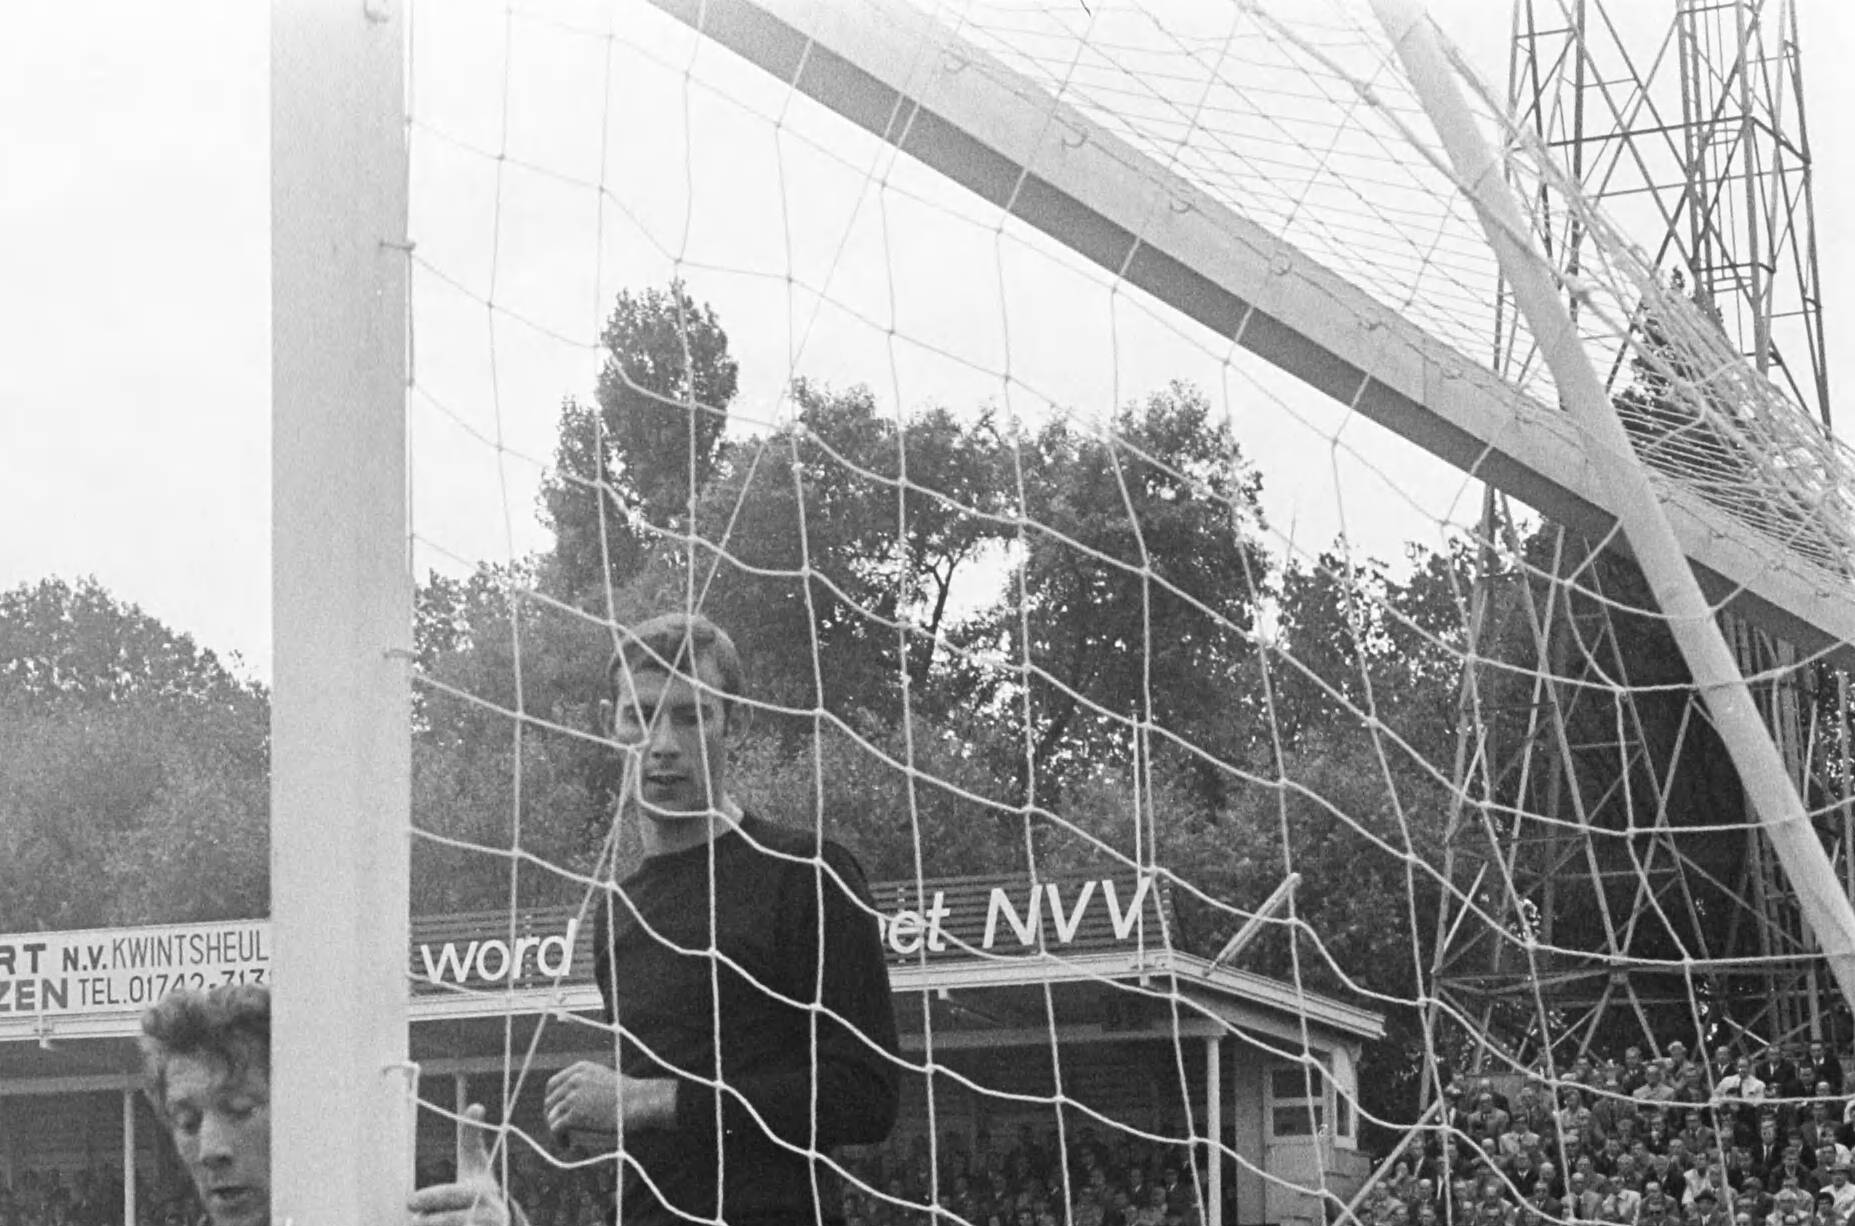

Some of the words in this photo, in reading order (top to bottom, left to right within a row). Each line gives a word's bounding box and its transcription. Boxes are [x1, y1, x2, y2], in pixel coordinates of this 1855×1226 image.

[112, 930, 269, 969] KWINTSHEUL
[420, 918, 578, 984] word
[878, 891, 951, 954] et
[983, 877, 1151, 949] NVV
